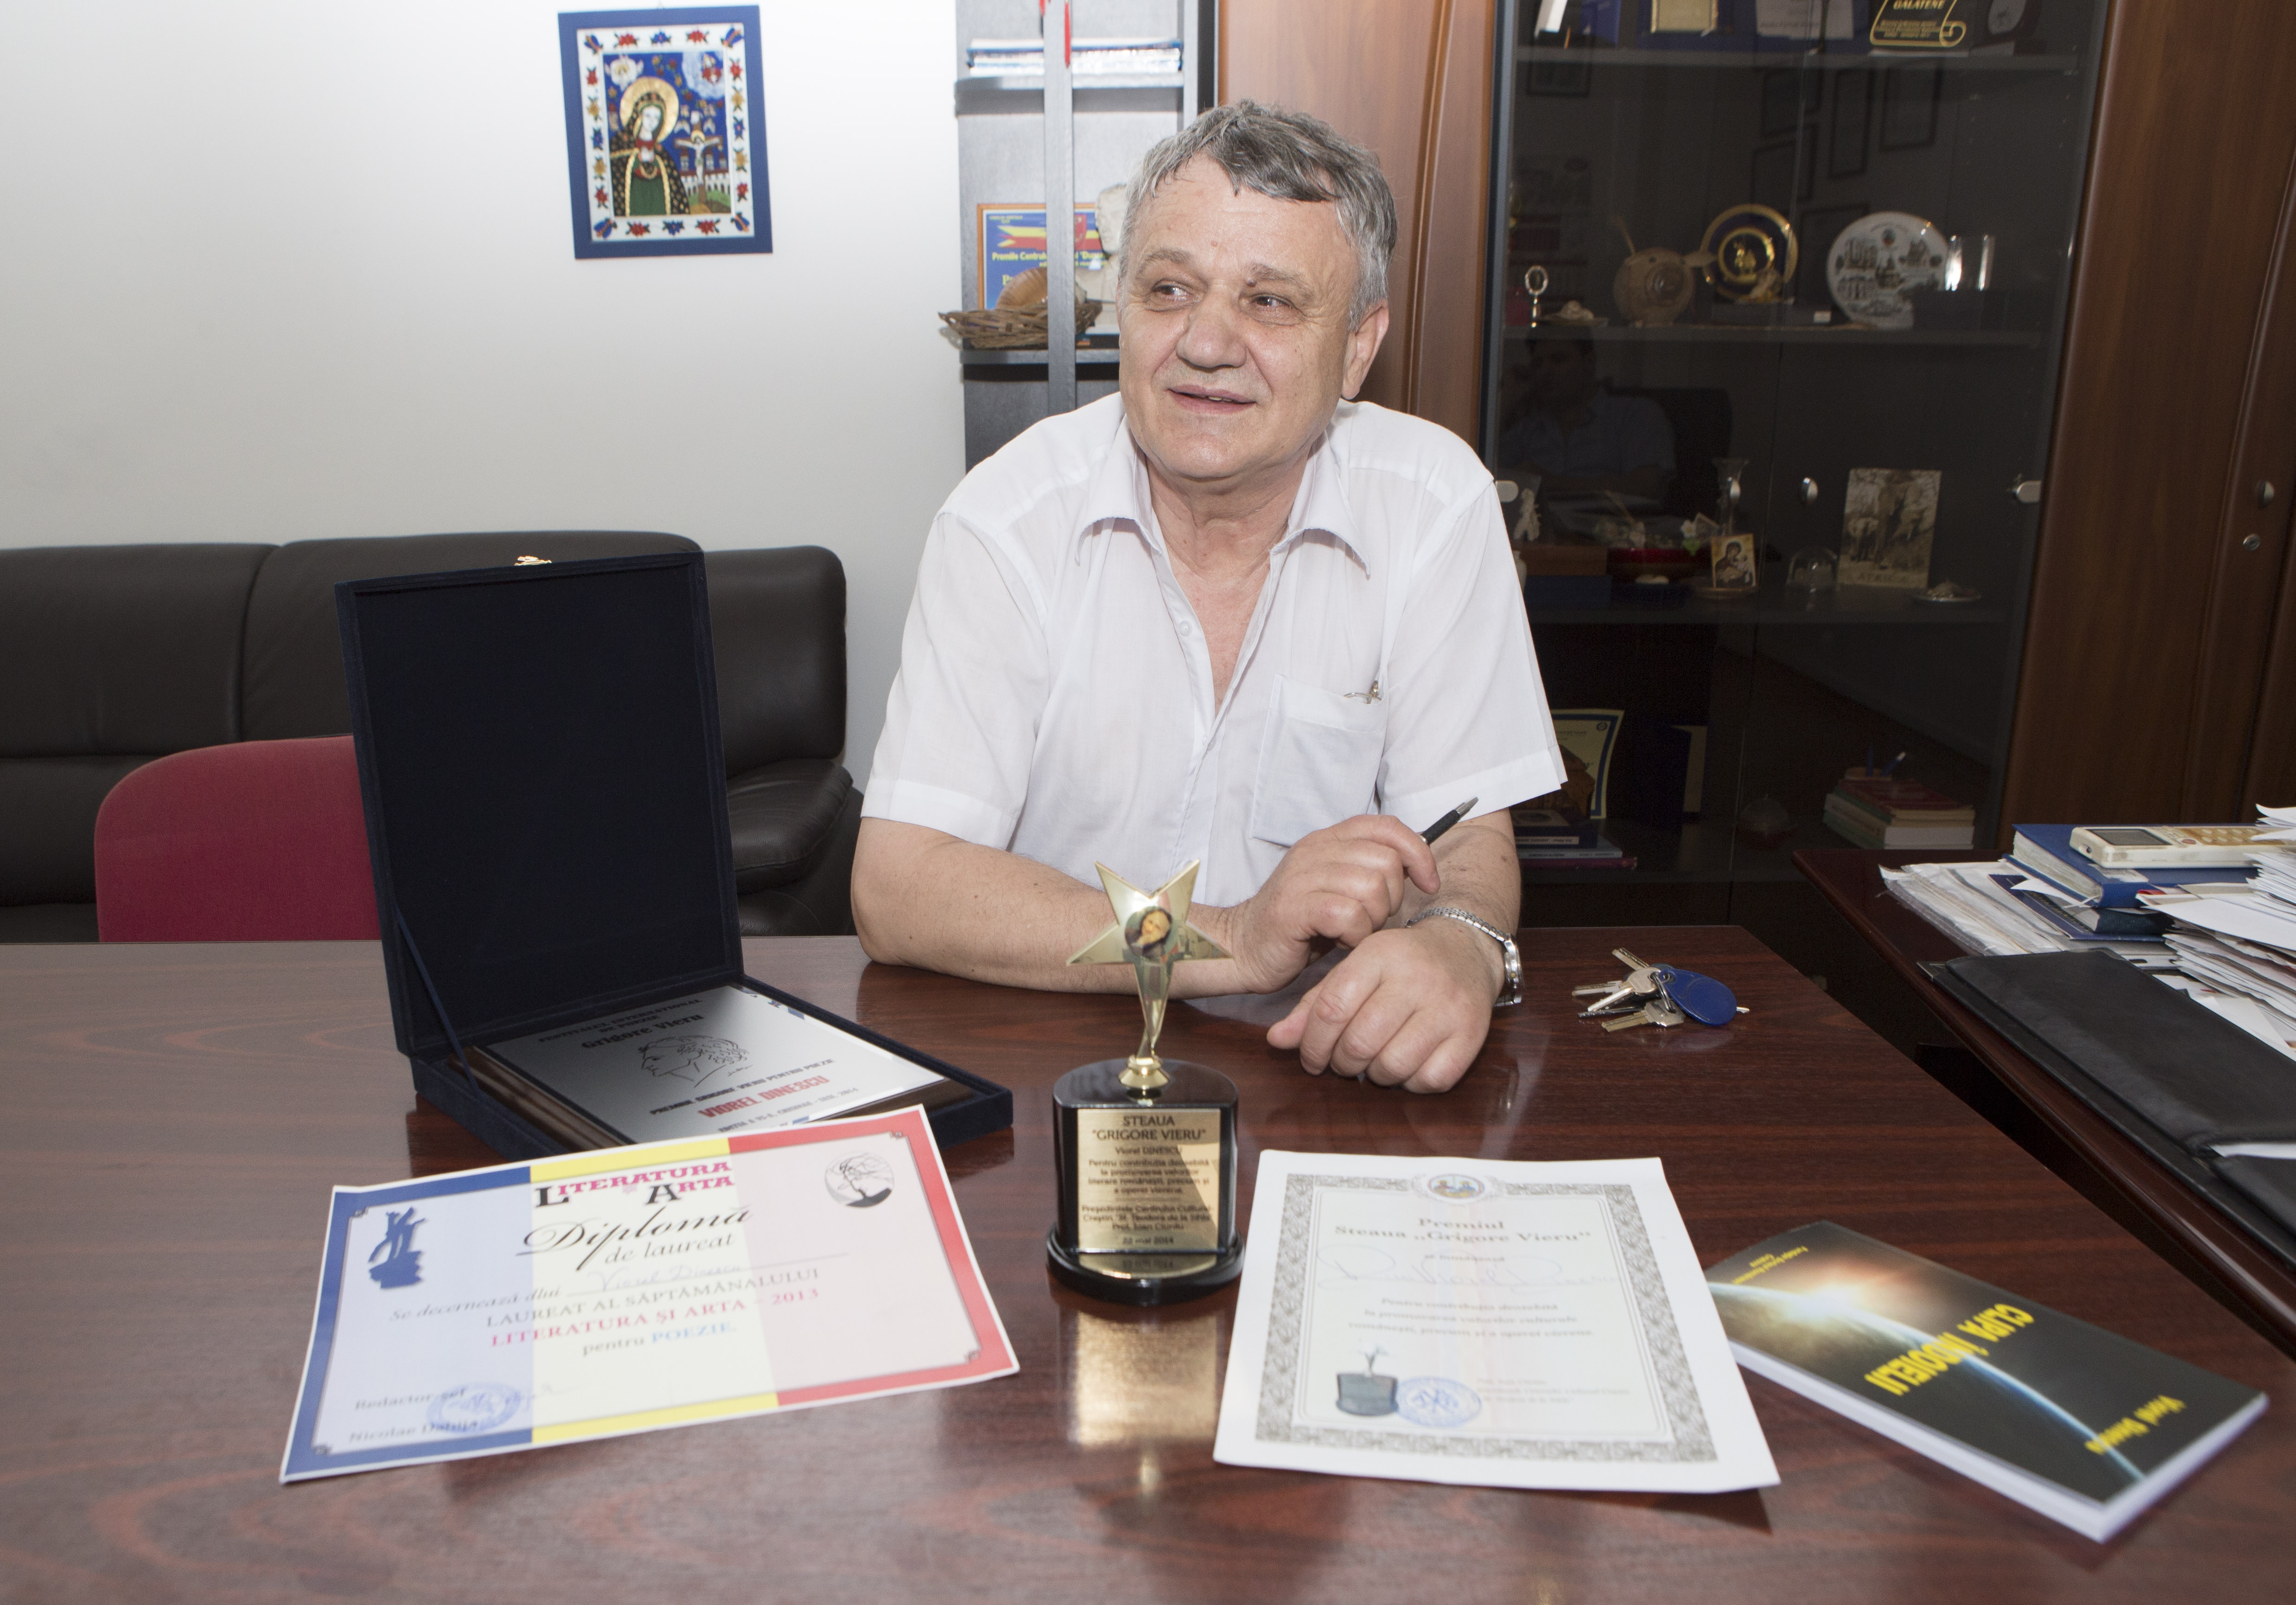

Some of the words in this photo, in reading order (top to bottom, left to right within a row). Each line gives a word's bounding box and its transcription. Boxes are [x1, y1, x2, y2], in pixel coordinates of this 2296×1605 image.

[581, 1028, 652, 1048] Grigore
[654, 1014, 705, 1029] Vieru
[699, 1096, 762, 1118] VIOREL
[758, 1075, 831, 1101] DINESCU
[1092, 1129, 1157, 1140] "GRIGORE
[1162, 1129, 1206, 1140] VIERU"
[1123, 1115, 1175, 1127] STEAUA
[1115, 1146, 1140, 1155] Viorel
[535, 1161, 732, 1208] LITERATURA
[644, 1176, 736, 1206] ARTA
[516, 1203, 756, 1272] Diplomă
[1334, 1225, 1407, 1238] Steaua
[1418, 1217, 1505, 1230] Premiul
[604, 1246, 635, 1264] de
[644, 1233, 735, 1258] laureat
[486, 1301, 588, 1328] LAUREAT
[593, 1297, 620, 1311] AL
[491, 1313, 649, 1347] LITERATURA
[684, 1299, 747, 1319] ARTA
[771, 1288, 819, 1306] 2013
[1956, 1303, 2035, 1345] CLIPA
[582, 1336, 645, 1357] pentru
